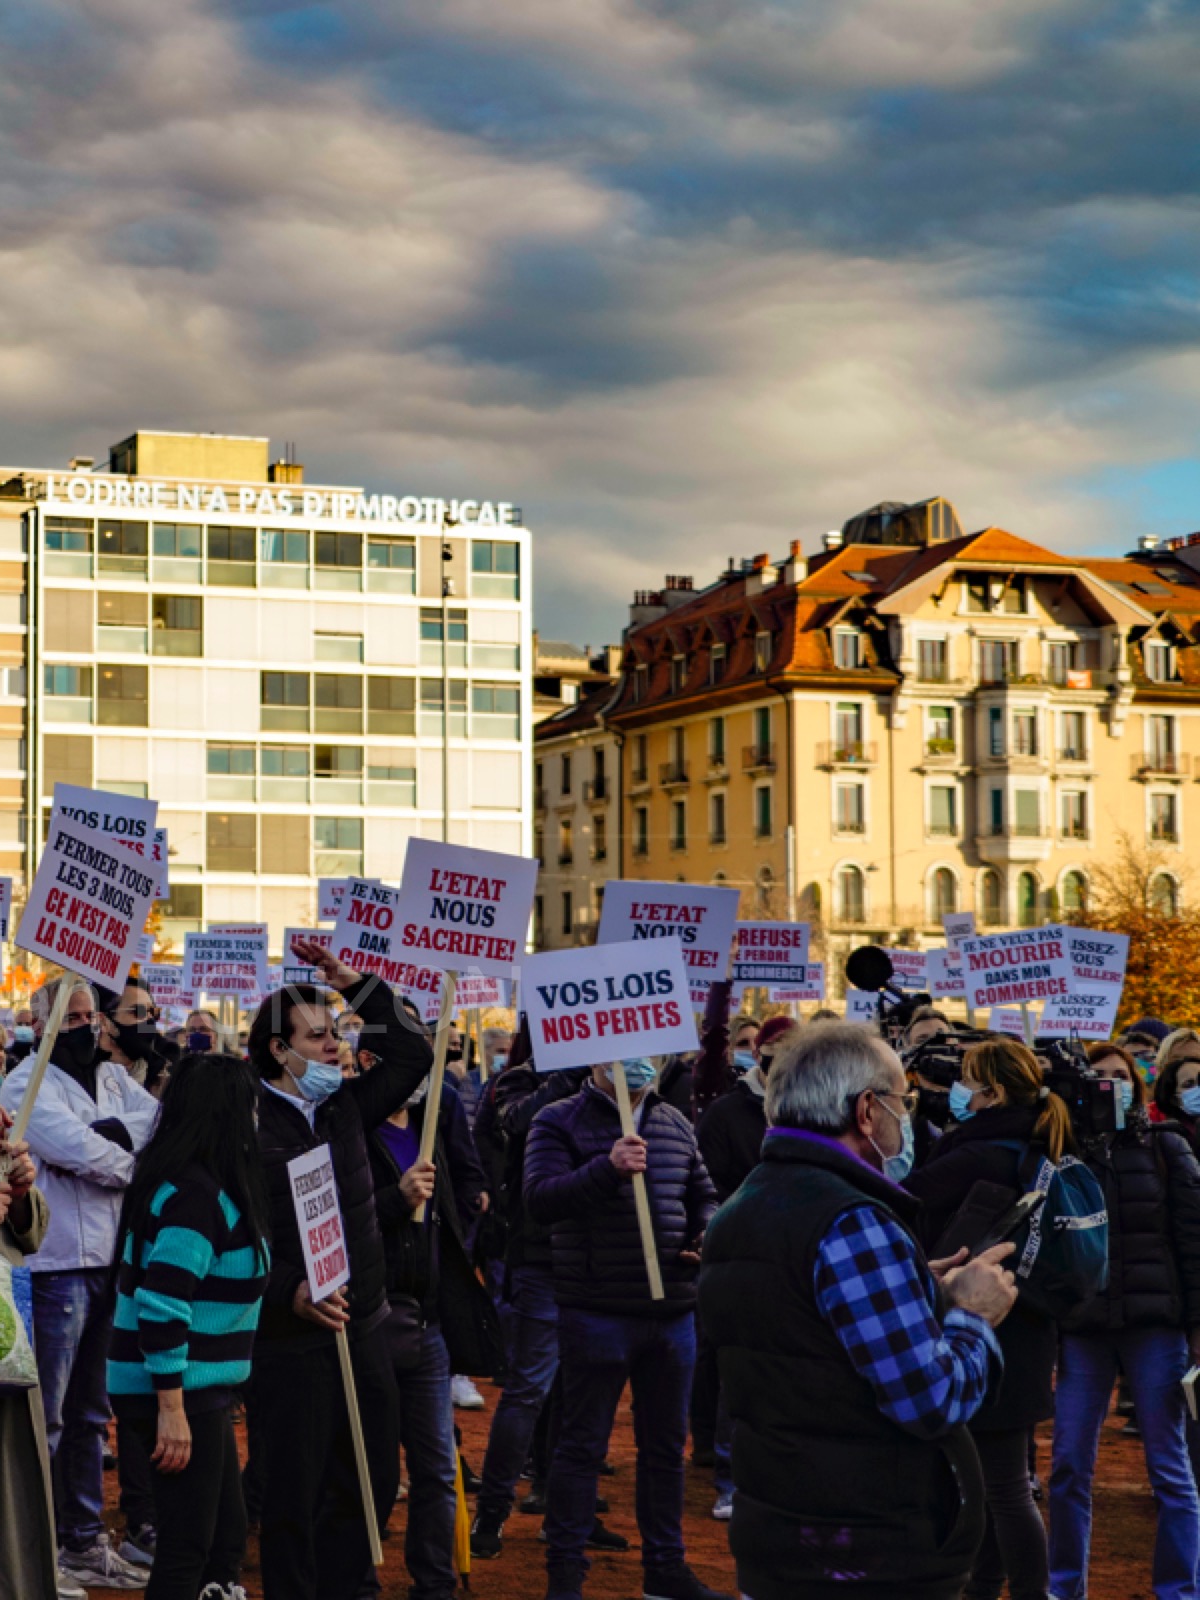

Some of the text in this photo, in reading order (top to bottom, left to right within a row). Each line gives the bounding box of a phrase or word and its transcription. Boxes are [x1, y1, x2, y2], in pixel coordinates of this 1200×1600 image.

[177, 484, 229, 511] N'A
[239, 487, 293, 516] PAS
[102, 813, 147, 837] LOIS
[53, 831, 120, 879] FERMER
[120, 863, 154, 898] TOUS
[56, 862, 135, 920] LES 3 MOIS,
[350, 882, 392, 904] JE NE
[429, 868, 506, 902] L'ETAT
[45, 887, 69, 918] CE
[66, 897, 109, 937] N'EST
[104, 916, 130, 949] PAS
[430, 897, 496, 928] NOUS
[629, 902, 707, 924] L'ETAT
[188, 938, 264, 950] FERMER TOUS
[358, 931, 390, 954] DAN
[402, 923, 517, 962] SACRIFIE!
[632, 924, 697, 943] NOUS
[738, 928, 801, 948] REFUSE
[963, 928, 1063, 953] JE NE VEUX PAS
[34, 917, 57, 948] LA
[56, 927, 121, 979] SOLUTION
[194, 950, 212, 960] LES
[744, 950, 790, 962] PERDRE
[968, 941, 1064, 971] MOURIR
[192, 962, 204, 975] CE
[237, 963, 256, 976] PAS
[338, 947, 443, 994] COMMERCE
[741, 966, 804, 980] COMMERCE
[985, 964, 1051, 986] DANS MON
[191, 976, 256, 990] LA SOLUTION
[536, 979, 598, 1010] VOS
[604, 969, 674, 1002] LOIS
[974, 977, 1068, 1006] COMMERCE
[541, 1001, 682, 1044] NOS PERTES
[1058, 1007, 1096, 1018] NOUS
